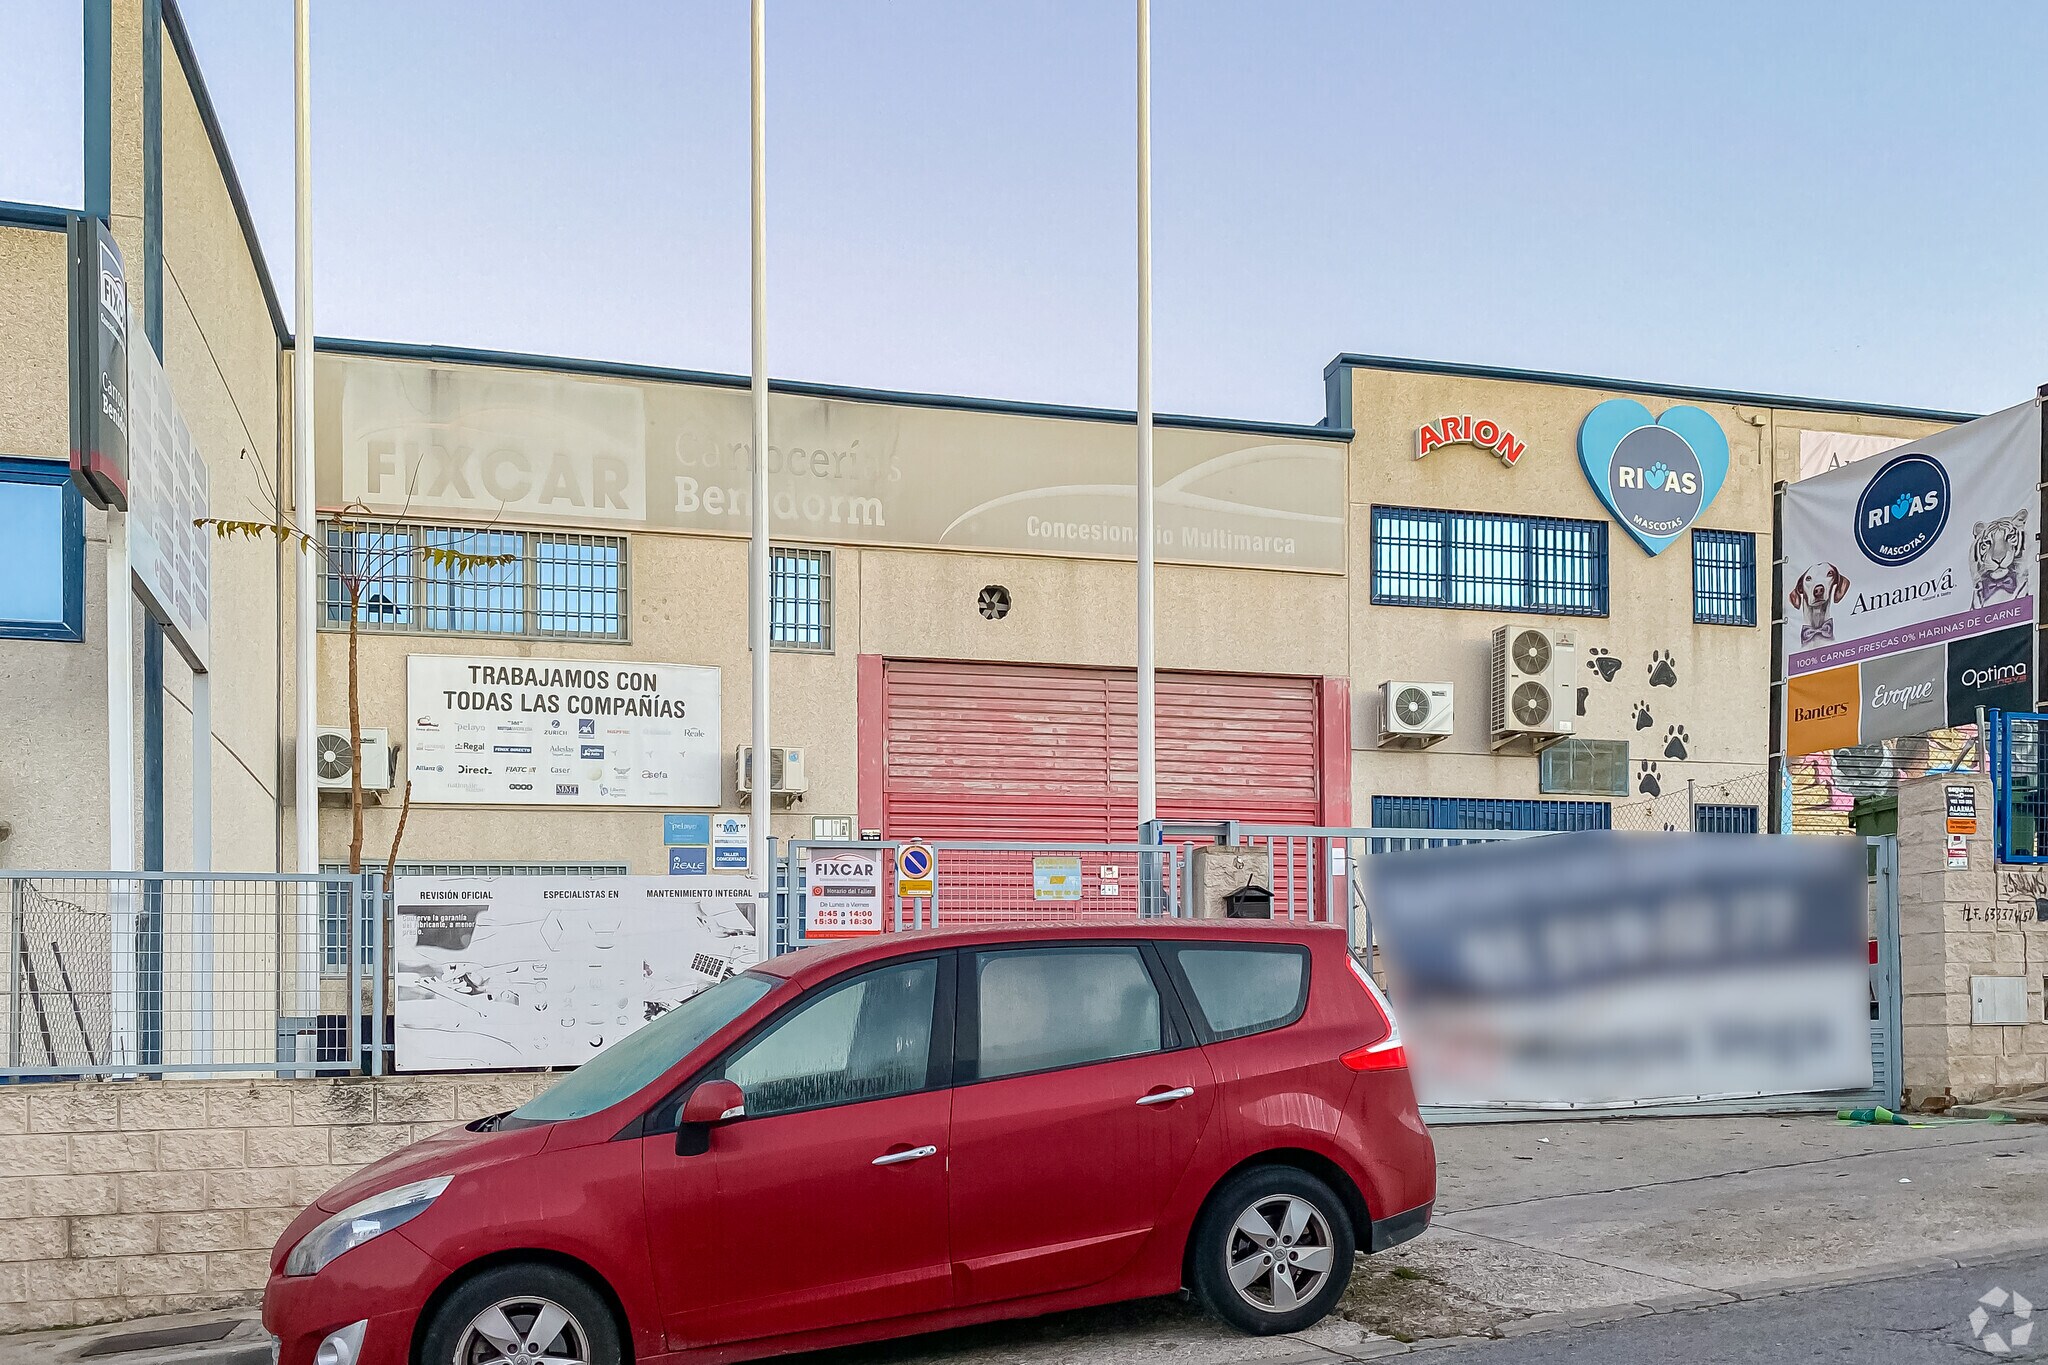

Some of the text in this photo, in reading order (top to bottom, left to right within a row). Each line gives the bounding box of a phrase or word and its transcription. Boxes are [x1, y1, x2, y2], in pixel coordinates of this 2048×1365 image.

[1417, 414, 1527, 467] ARION
[366, 440, 632, 511] FIXCAR
[674, 475, 886, 527] Bendorm
[1633, 514, 1684, 531] MASCOTAS
[1026, 515, 1296, 554] Concesionio Multimarca
[1879, 533, 1926, 556] MASCOTAS
[1796, 606, 2022, 668] 100% CARNES FRESCAS 0% HARINAS DE CARNE
[467, 665, 658, 692] TRABAJAMOS CON
[1961, 662, 2027, 689] Optima
[443, 690, 686, 719] TODAS LAS COMPAÑÍAS
[1871, 679, 1934, 710] Evoque
[1794, 701, 1849, 722] Banters
[684, 729, 705, 738] Reale
[463, 742, 485, 752] Regal
[815, 863, 874, 876] FIXCAR
[420, 889, 494, 899] REVISIÓN OFICIAL
[543, 890, 619, 899] ESPECIALISTAS EN
[646, 889, 753, 898] MANTENIMIENTO INTEGRAL
[440, 913, 467, 922] garantía
